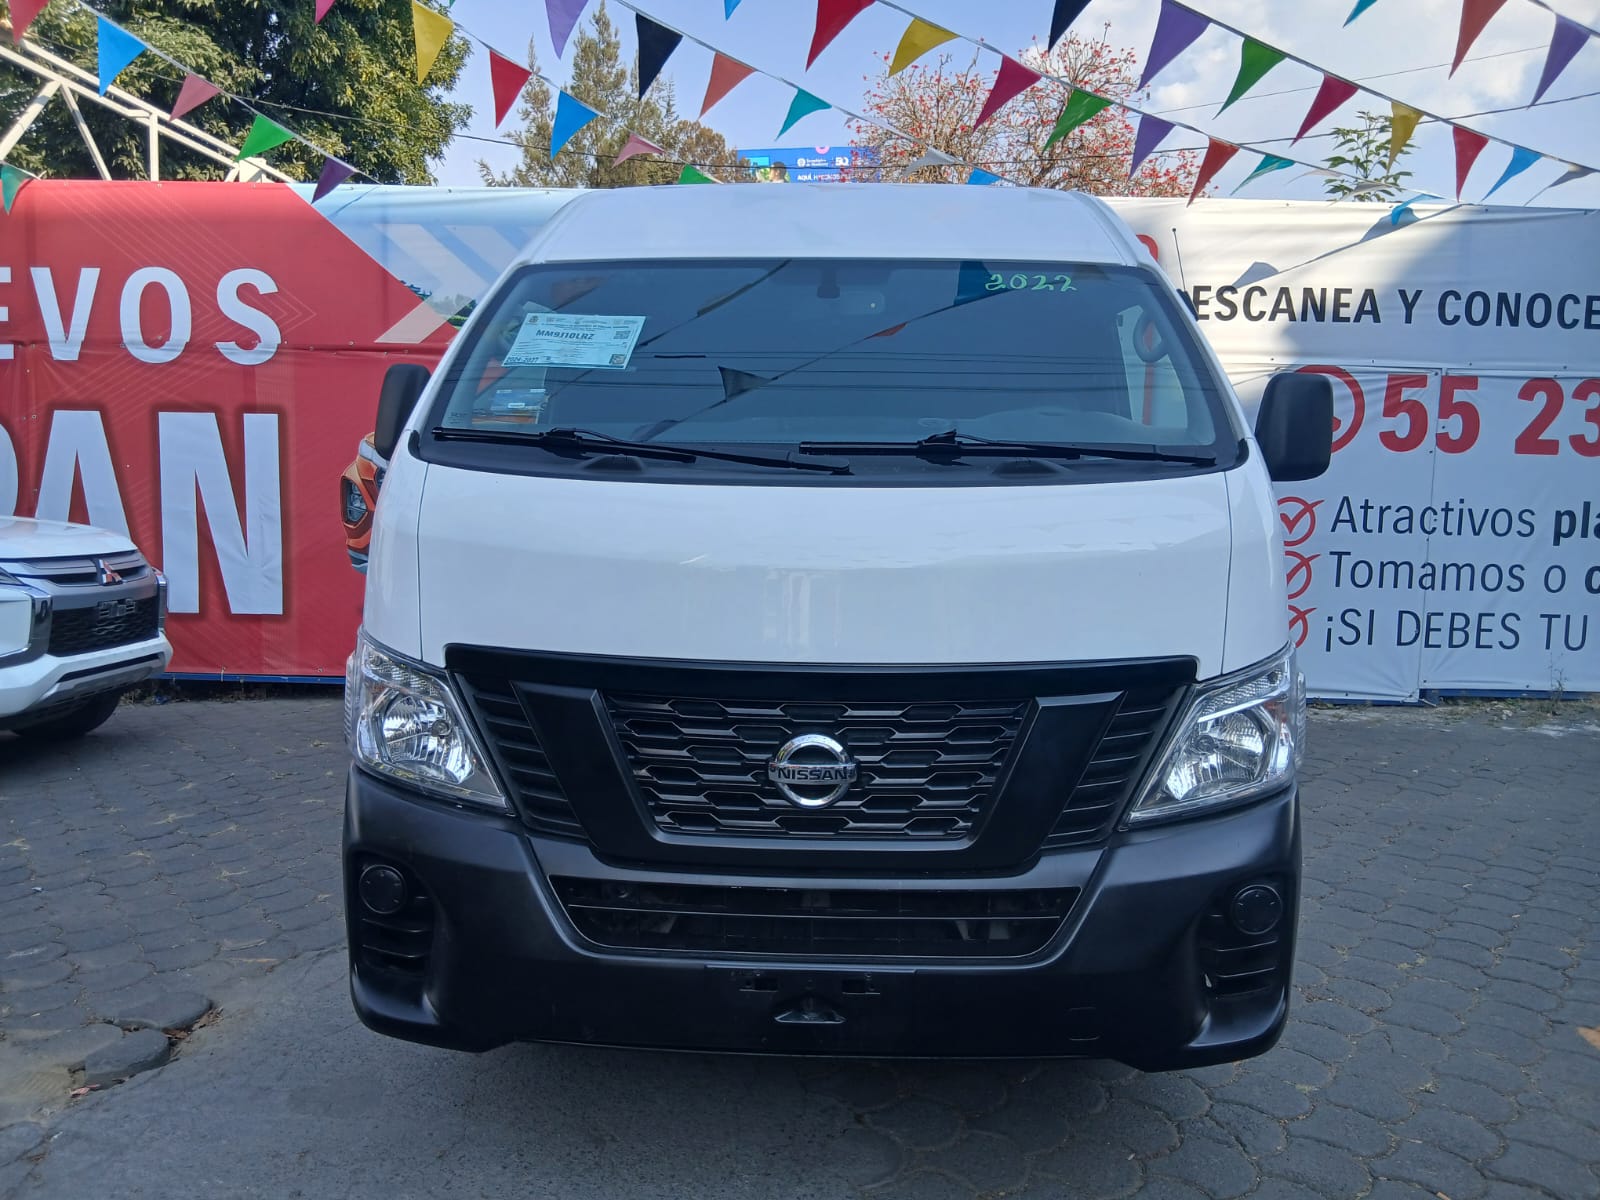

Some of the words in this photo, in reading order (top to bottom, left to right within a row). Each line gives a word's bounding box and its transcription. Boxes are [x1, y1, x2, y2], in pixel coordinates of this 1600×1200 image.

[985, 273, 1077, 292] 2022
[0, 266, 282, 365] VOS
[1192, 285, 1381, 324] ESCANEA
[1397, 288, 1424, 325] Y
[1437, 289, 1600, 330] CONOCE
[1379, 374, 1480, 454] 55
[1330, 496, 1536, 538] Atractivos
[1329, 551, 1526, 592] Tomamos
[1543, 564, 1567, 594] o
[1325, 608, 1375, 652] ¡SI
[1396, 610, 1521, 650] DEBES
[1540, 613, 1589, 651] TU
[777, 767, 848, 781] NISSAN
